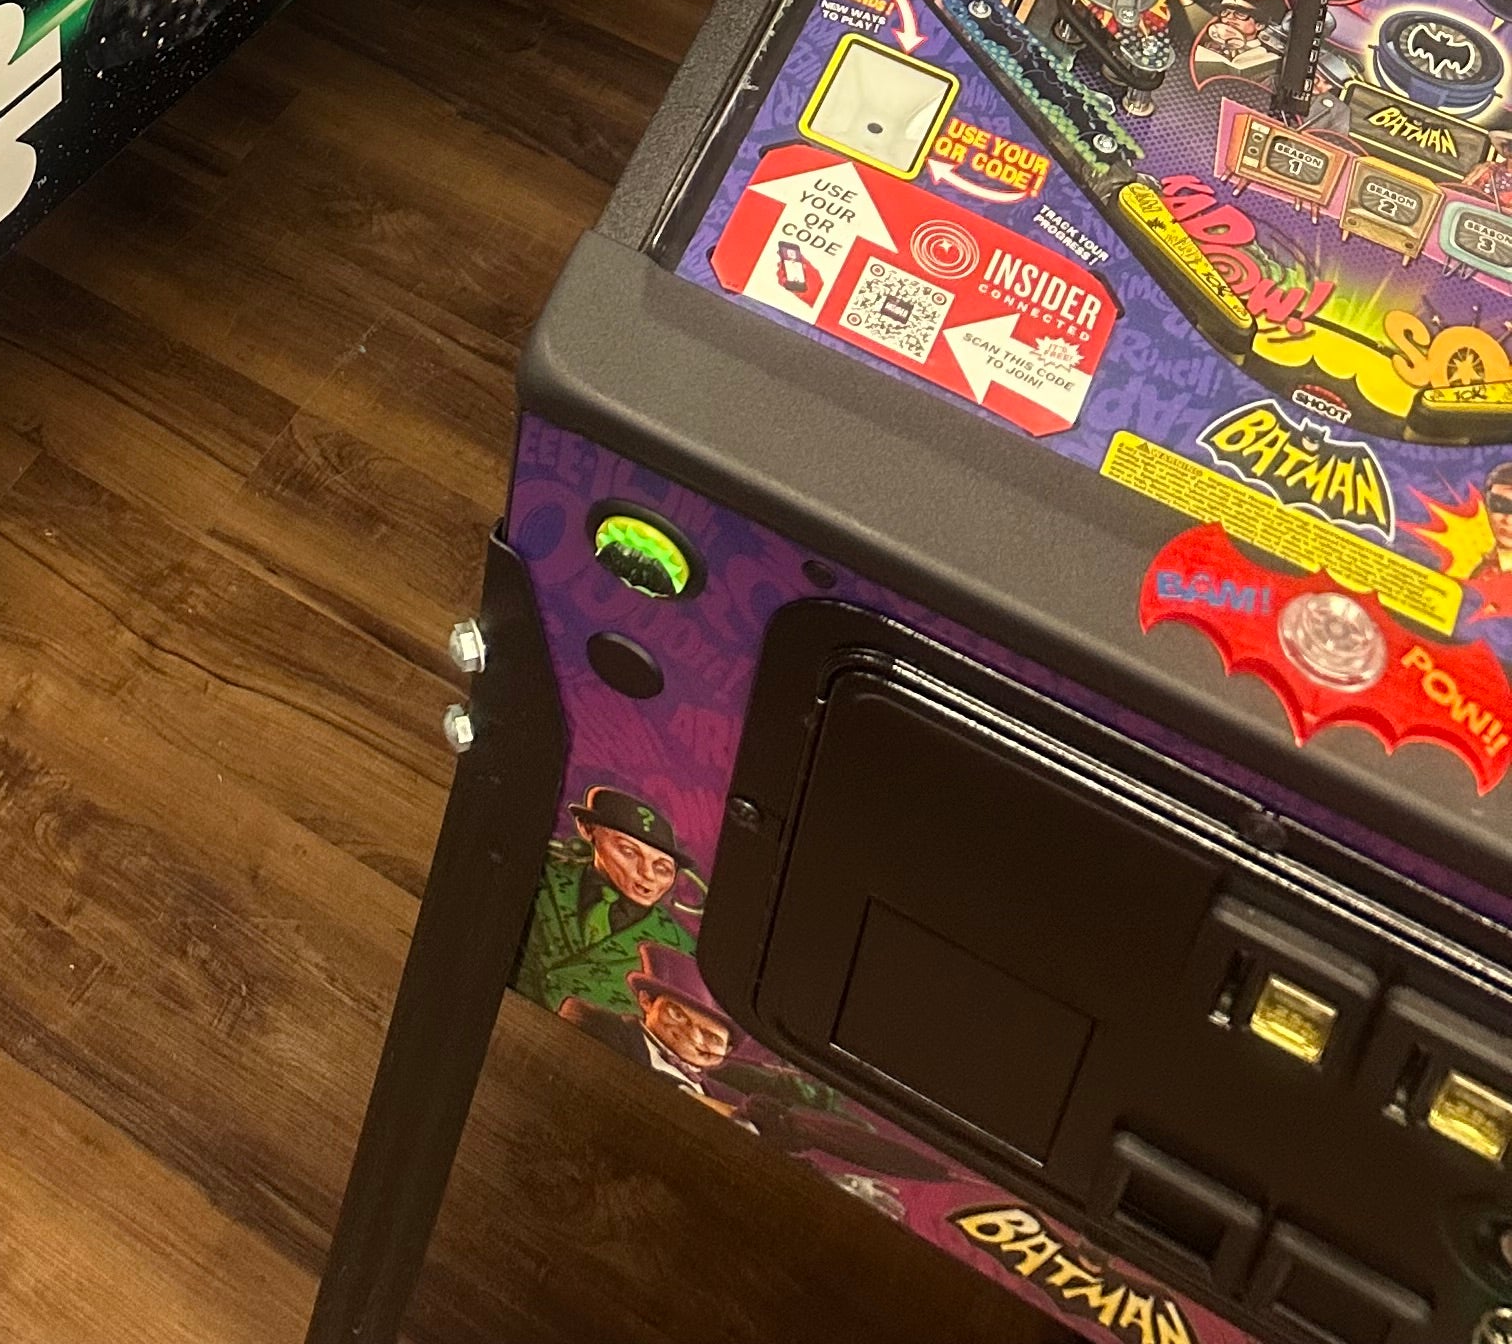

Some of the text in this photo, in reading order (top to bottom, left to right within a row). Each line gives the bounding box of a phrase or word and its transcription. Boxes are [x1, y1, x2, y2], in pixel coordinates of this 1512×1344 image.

[821, 0, 886, 26] NEW WAYS
[822, 10, 840, 22] TO
[935, 135, 966, 163] QR
[948, 118, 1051, 174] USE YOUR
[1368, 107, 1458, 158] BATMAN
[1275, 142, 1323, 168] SEASON
[1289, 160, 1301, 174] 1
[799, 191, 856, 224] YOUR
[814, 178, 857, 204] USE
[1367, 182, 1416, 208] SEASON
[1378, 199, 1398, 215] 2
[781, 223, 842, 256] CODE
[804, 213, 834, 234] QR
[1033, 213, 1099, 265] PROGRESS!
[1039, 205, 1110, 262] TRACK YOUR
[1479, 236, 1496, 253] 3
[983, 249, 1103, 329] INSIDER
[978, 283, 1091, 343] CONNECTED
[962, 332, 1075, 392] SCAN THIS CODE
[986, 355, 1045, 390] TO JOIN!
[1044, 348, 1074, 364] FREE!
[1293, 390, 1351, 424] SHOOT
[1150, 448, 1204, 478] WARNING
[1211, 408, 1387, 525] BATMAN
[1156, 571, 1271, 615] BAM!
[949, 1205, 1197, 1344] BATMAN
